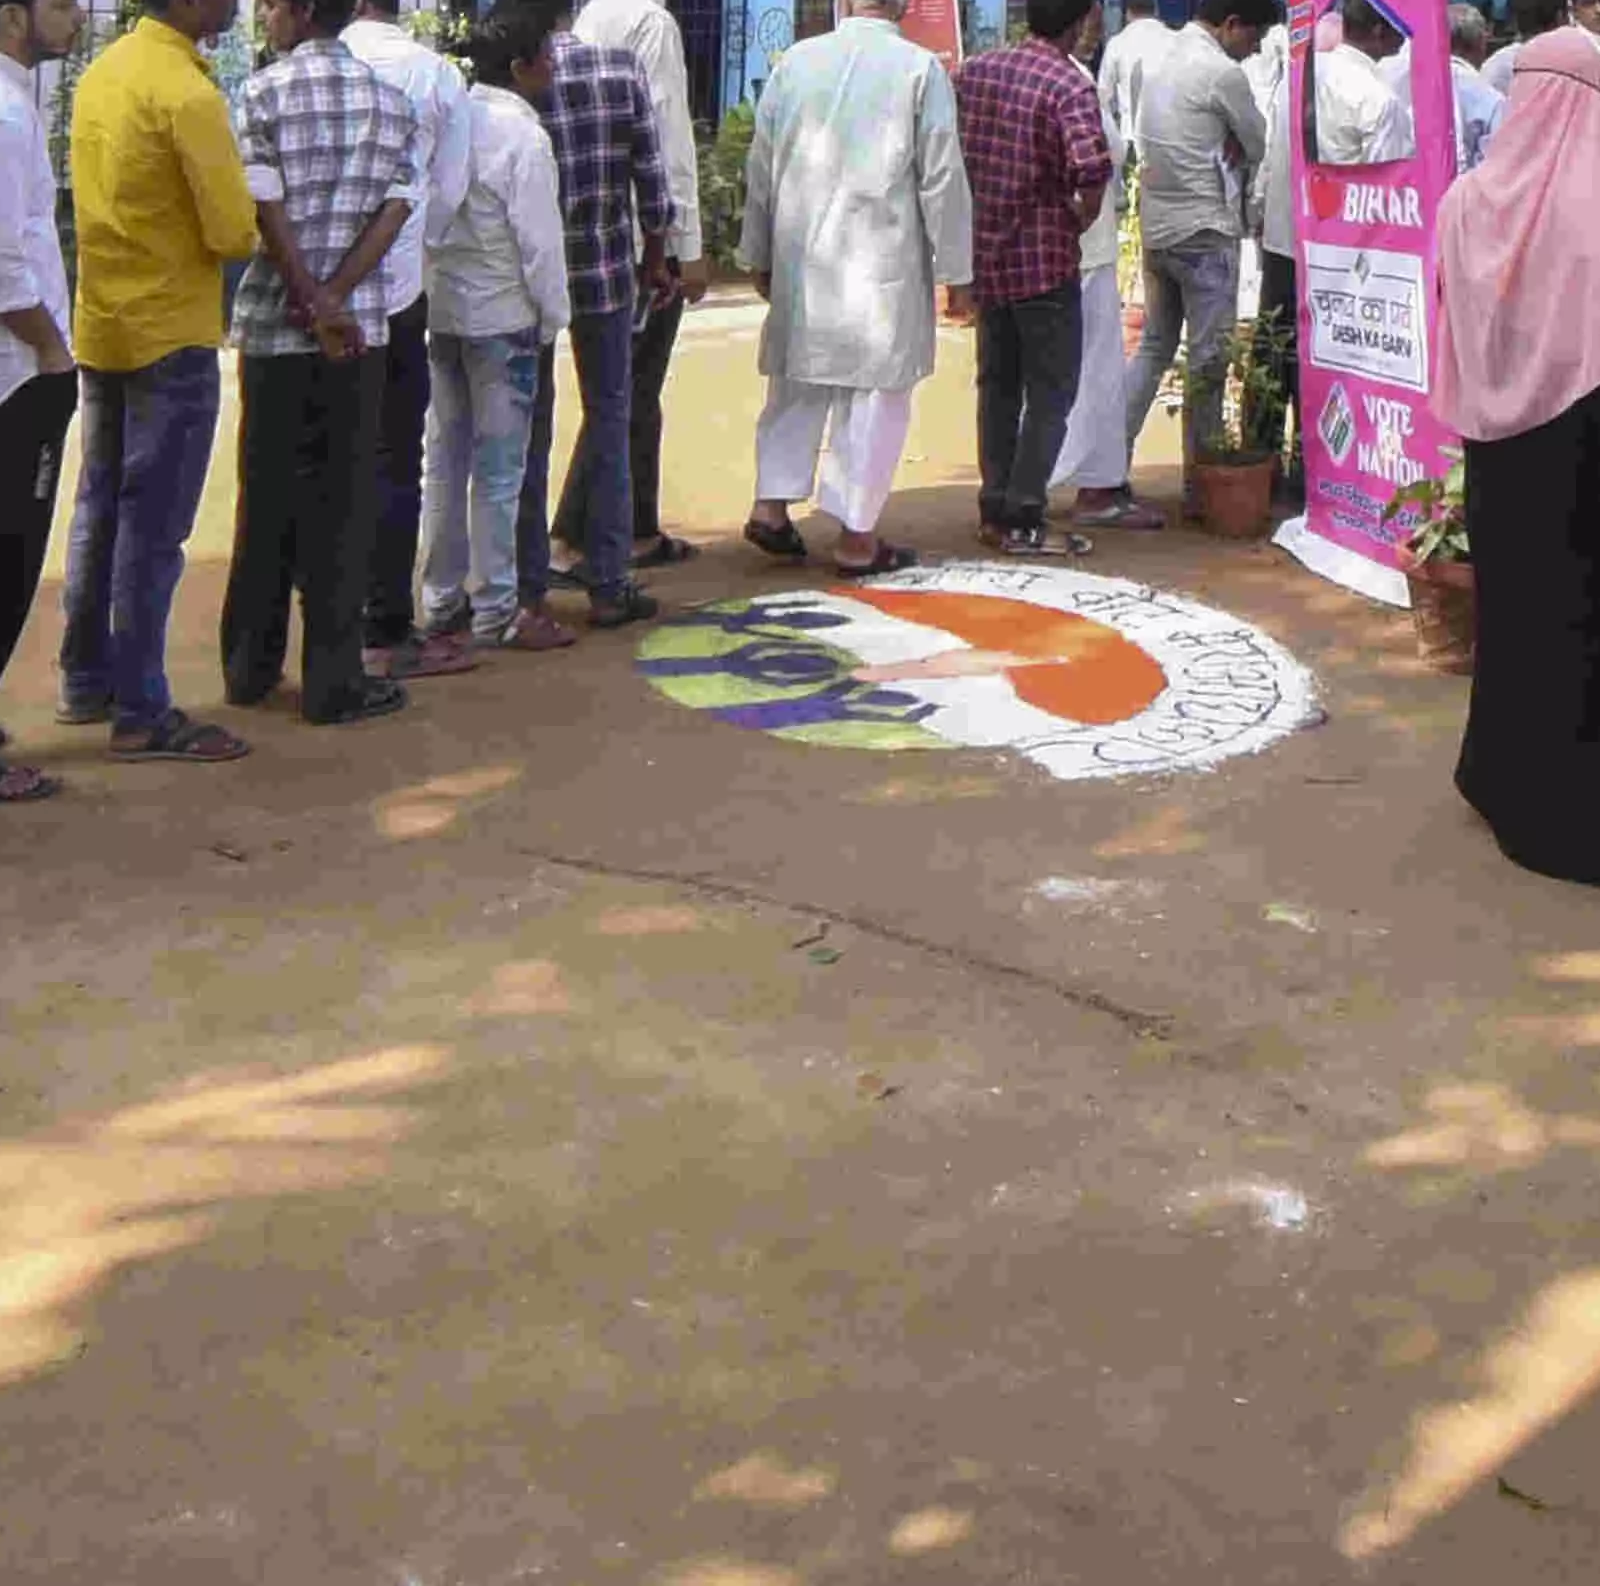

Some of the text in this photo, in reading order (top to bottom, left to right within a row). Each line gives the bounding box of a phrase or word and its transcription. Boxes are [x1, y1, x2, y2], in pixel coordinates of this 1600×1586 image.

[1343, 182, 1424, 230] BIHAR
[1331, 323, 1362, 345] DESH
[1364, 326, 1380, 348] KA
[1381, 331, 1413, 358] GARV
[1361, 393, 1415, 435] VOTE
[1356, 442, 1426, 487] NATION
